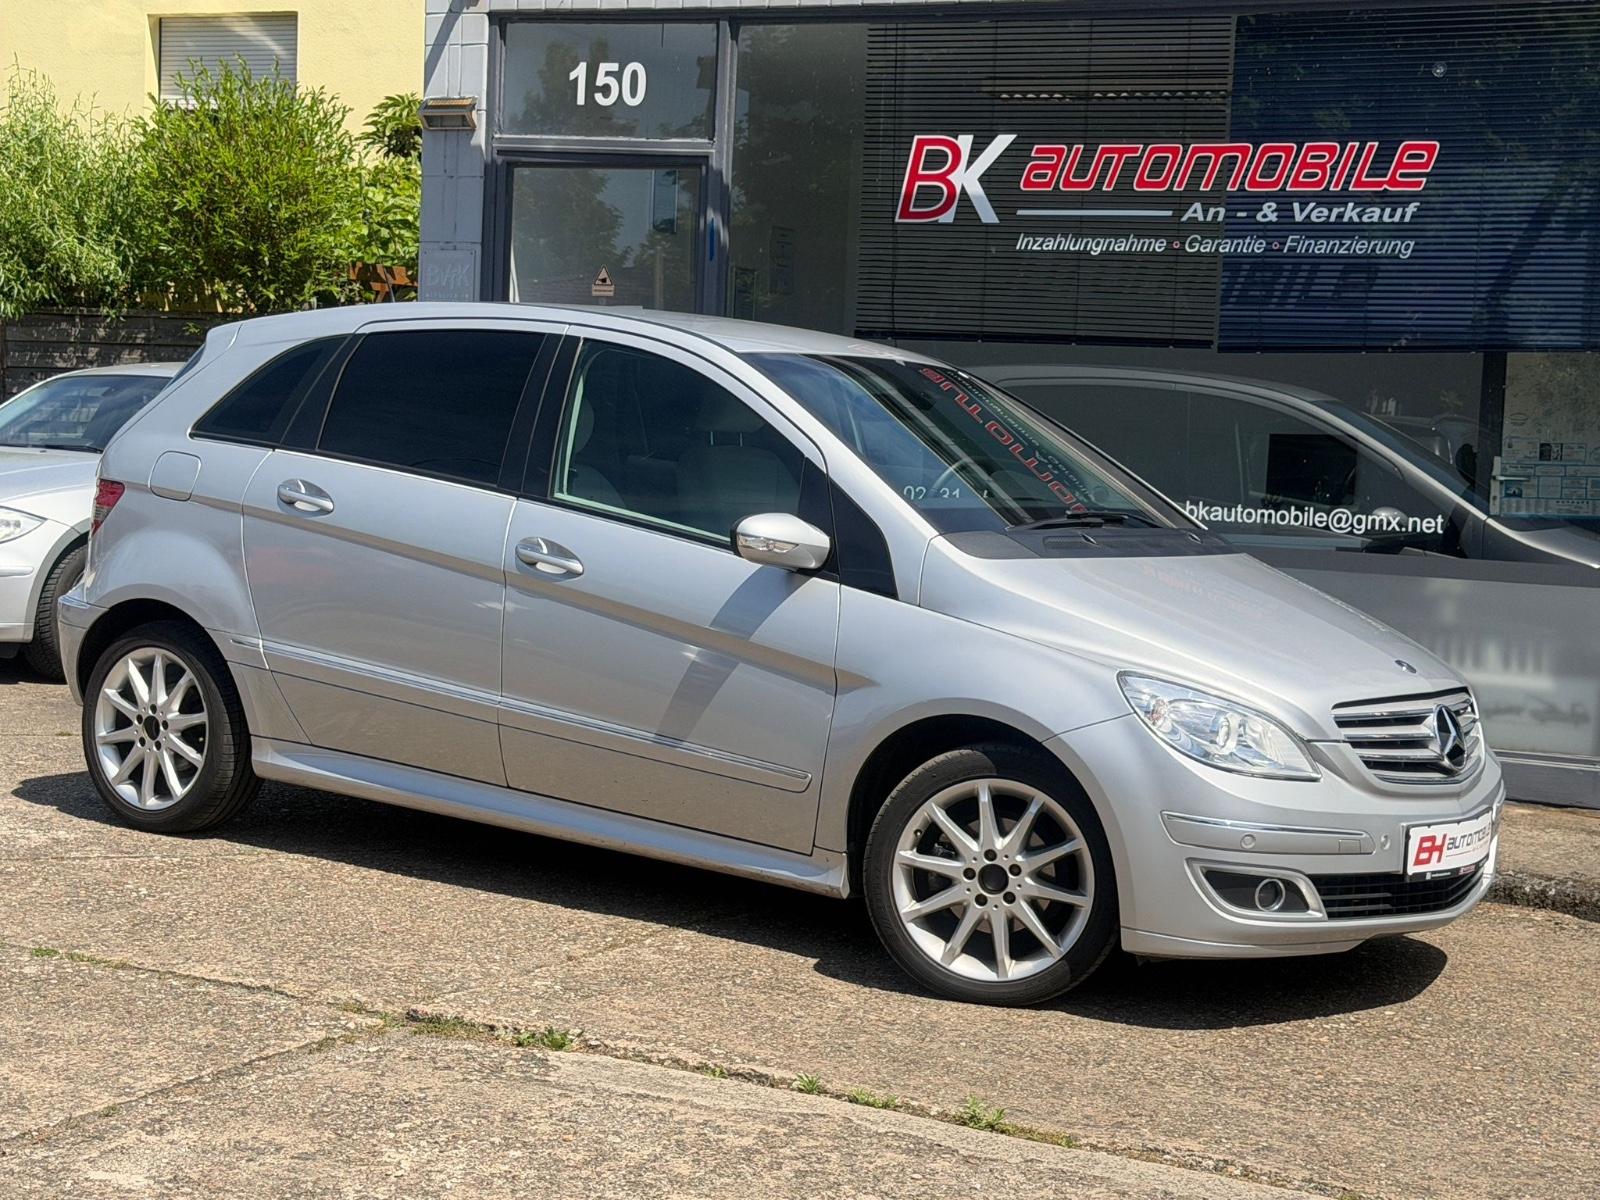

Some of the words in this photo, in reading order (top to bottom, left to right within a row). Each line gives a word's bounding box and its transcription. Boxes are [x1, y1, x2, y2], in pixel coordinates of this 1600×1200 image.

[568, 61, 647, 107] 150
[894, 134, 1018, 224] BK
[1180, 202, 1226, 222] An
[1255, 202, 1279, 222] &
[1291, 201, 1421, 223] Verkauf
[1015, 232, 1167, 256] Inzahlungnahme
[1184, 234, 1266, 254] Garantie
[1282, 235, 1416, 259] Finanzierung
[1185, 500, 1445, 534] bkautomobile@gmx.net
